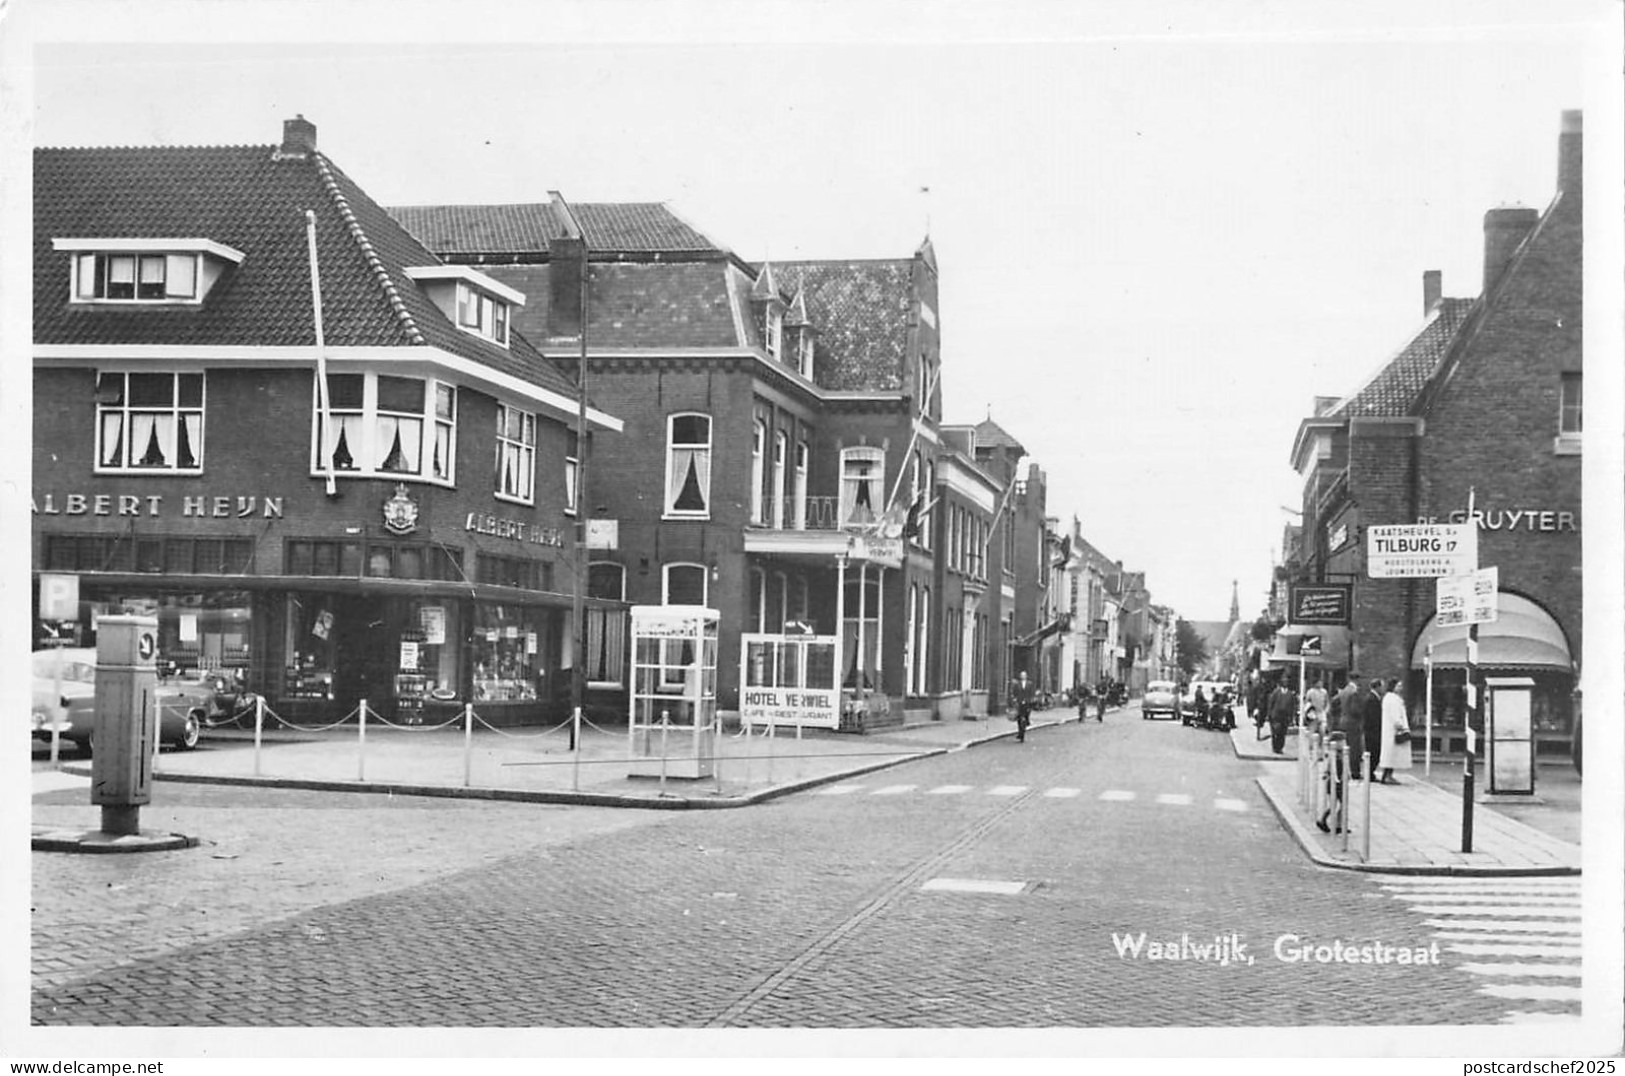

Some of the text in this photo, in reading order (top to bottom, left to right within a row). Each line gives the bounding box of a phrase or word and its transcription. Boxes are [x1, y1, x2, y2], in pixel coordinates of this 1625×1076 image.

[465, 512, 526, 541] ALBERT
[1450, 510, 1575, 531] GRUYTER
[1375, 539, 1457, 553] TILBURG 17
[47, 579, 70, 616] P
[745, 692, 833, 709] HOTEL VERWIEL
